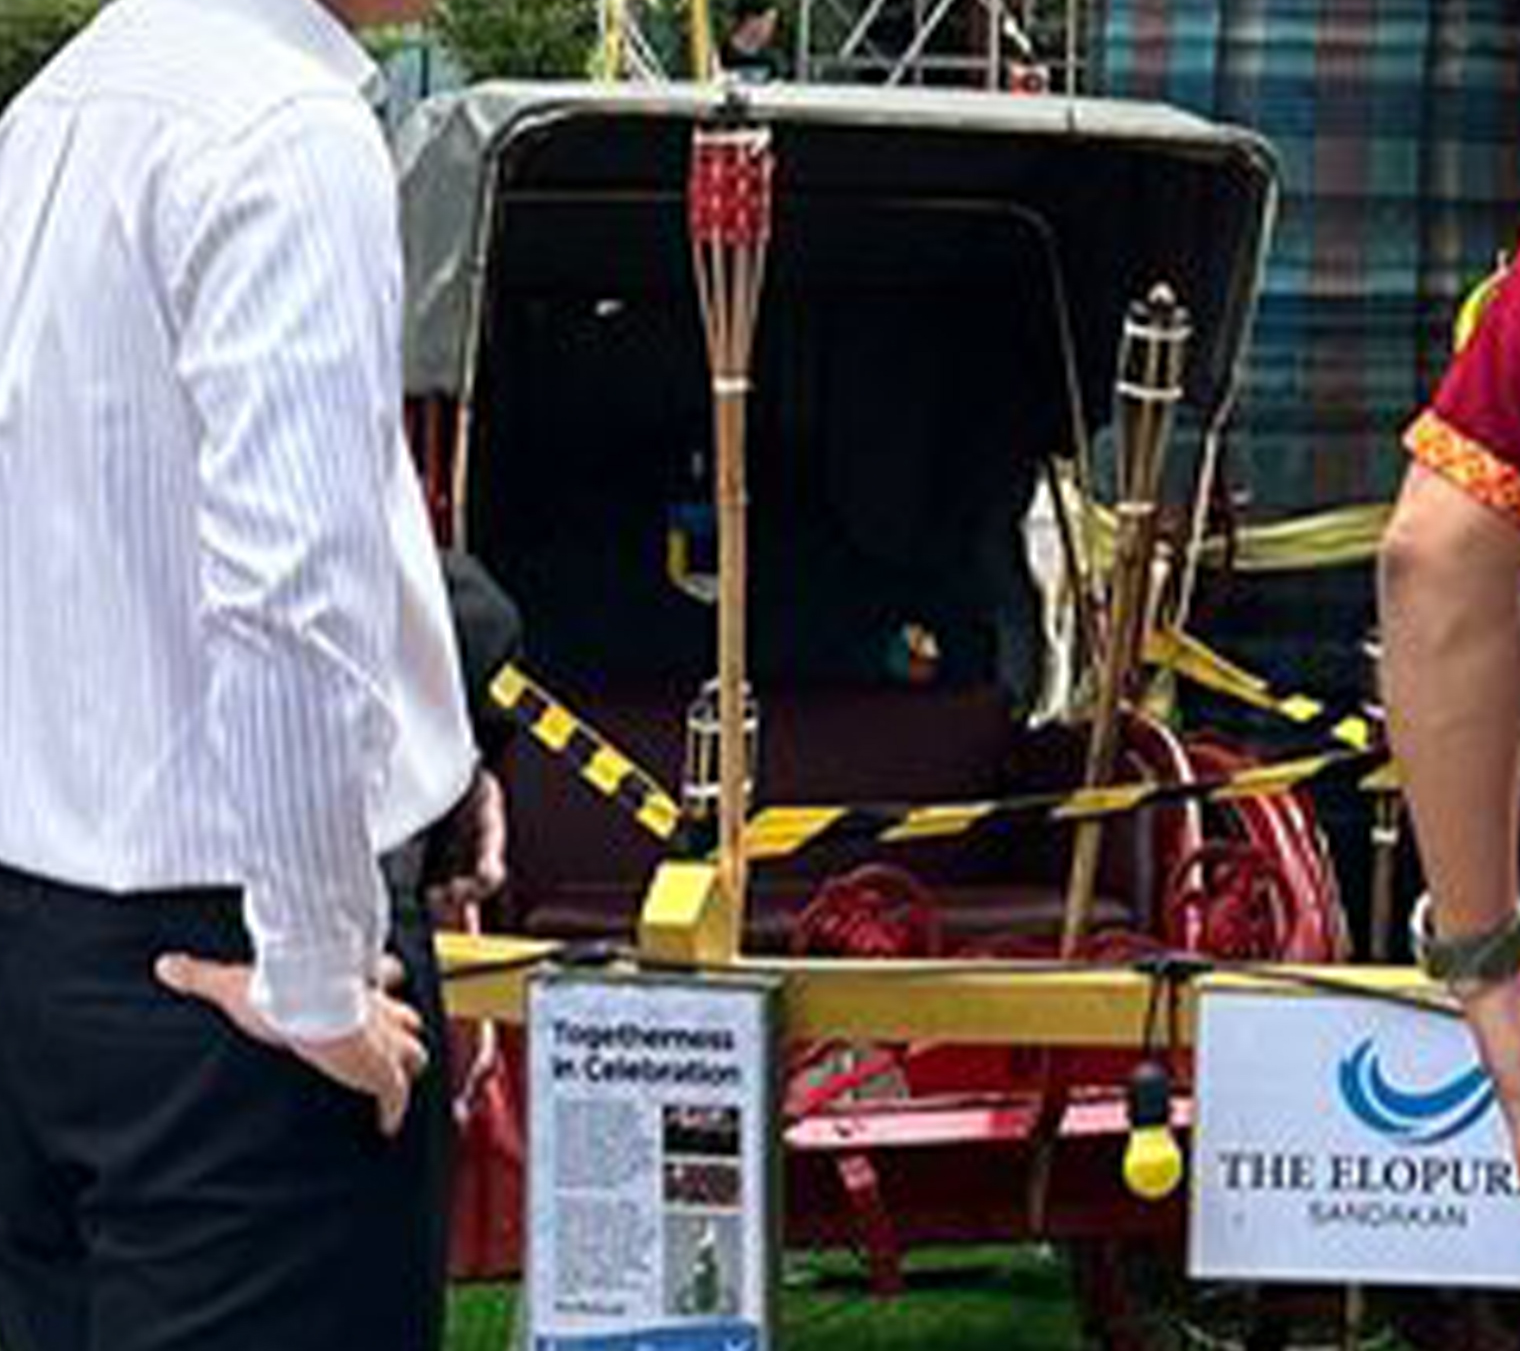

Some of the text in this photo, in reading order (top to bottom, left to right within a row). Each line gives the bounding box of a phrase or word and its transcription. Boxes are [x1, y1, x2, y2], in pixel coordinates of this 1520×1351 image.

[551, 1020, 735, 1051] Togetherness
[584, 1053, 741, 1088] Celebration
[1219, 1153, 1316, 1191] THE
[1309, 1200, 1468, 1228] SANDAKAN
